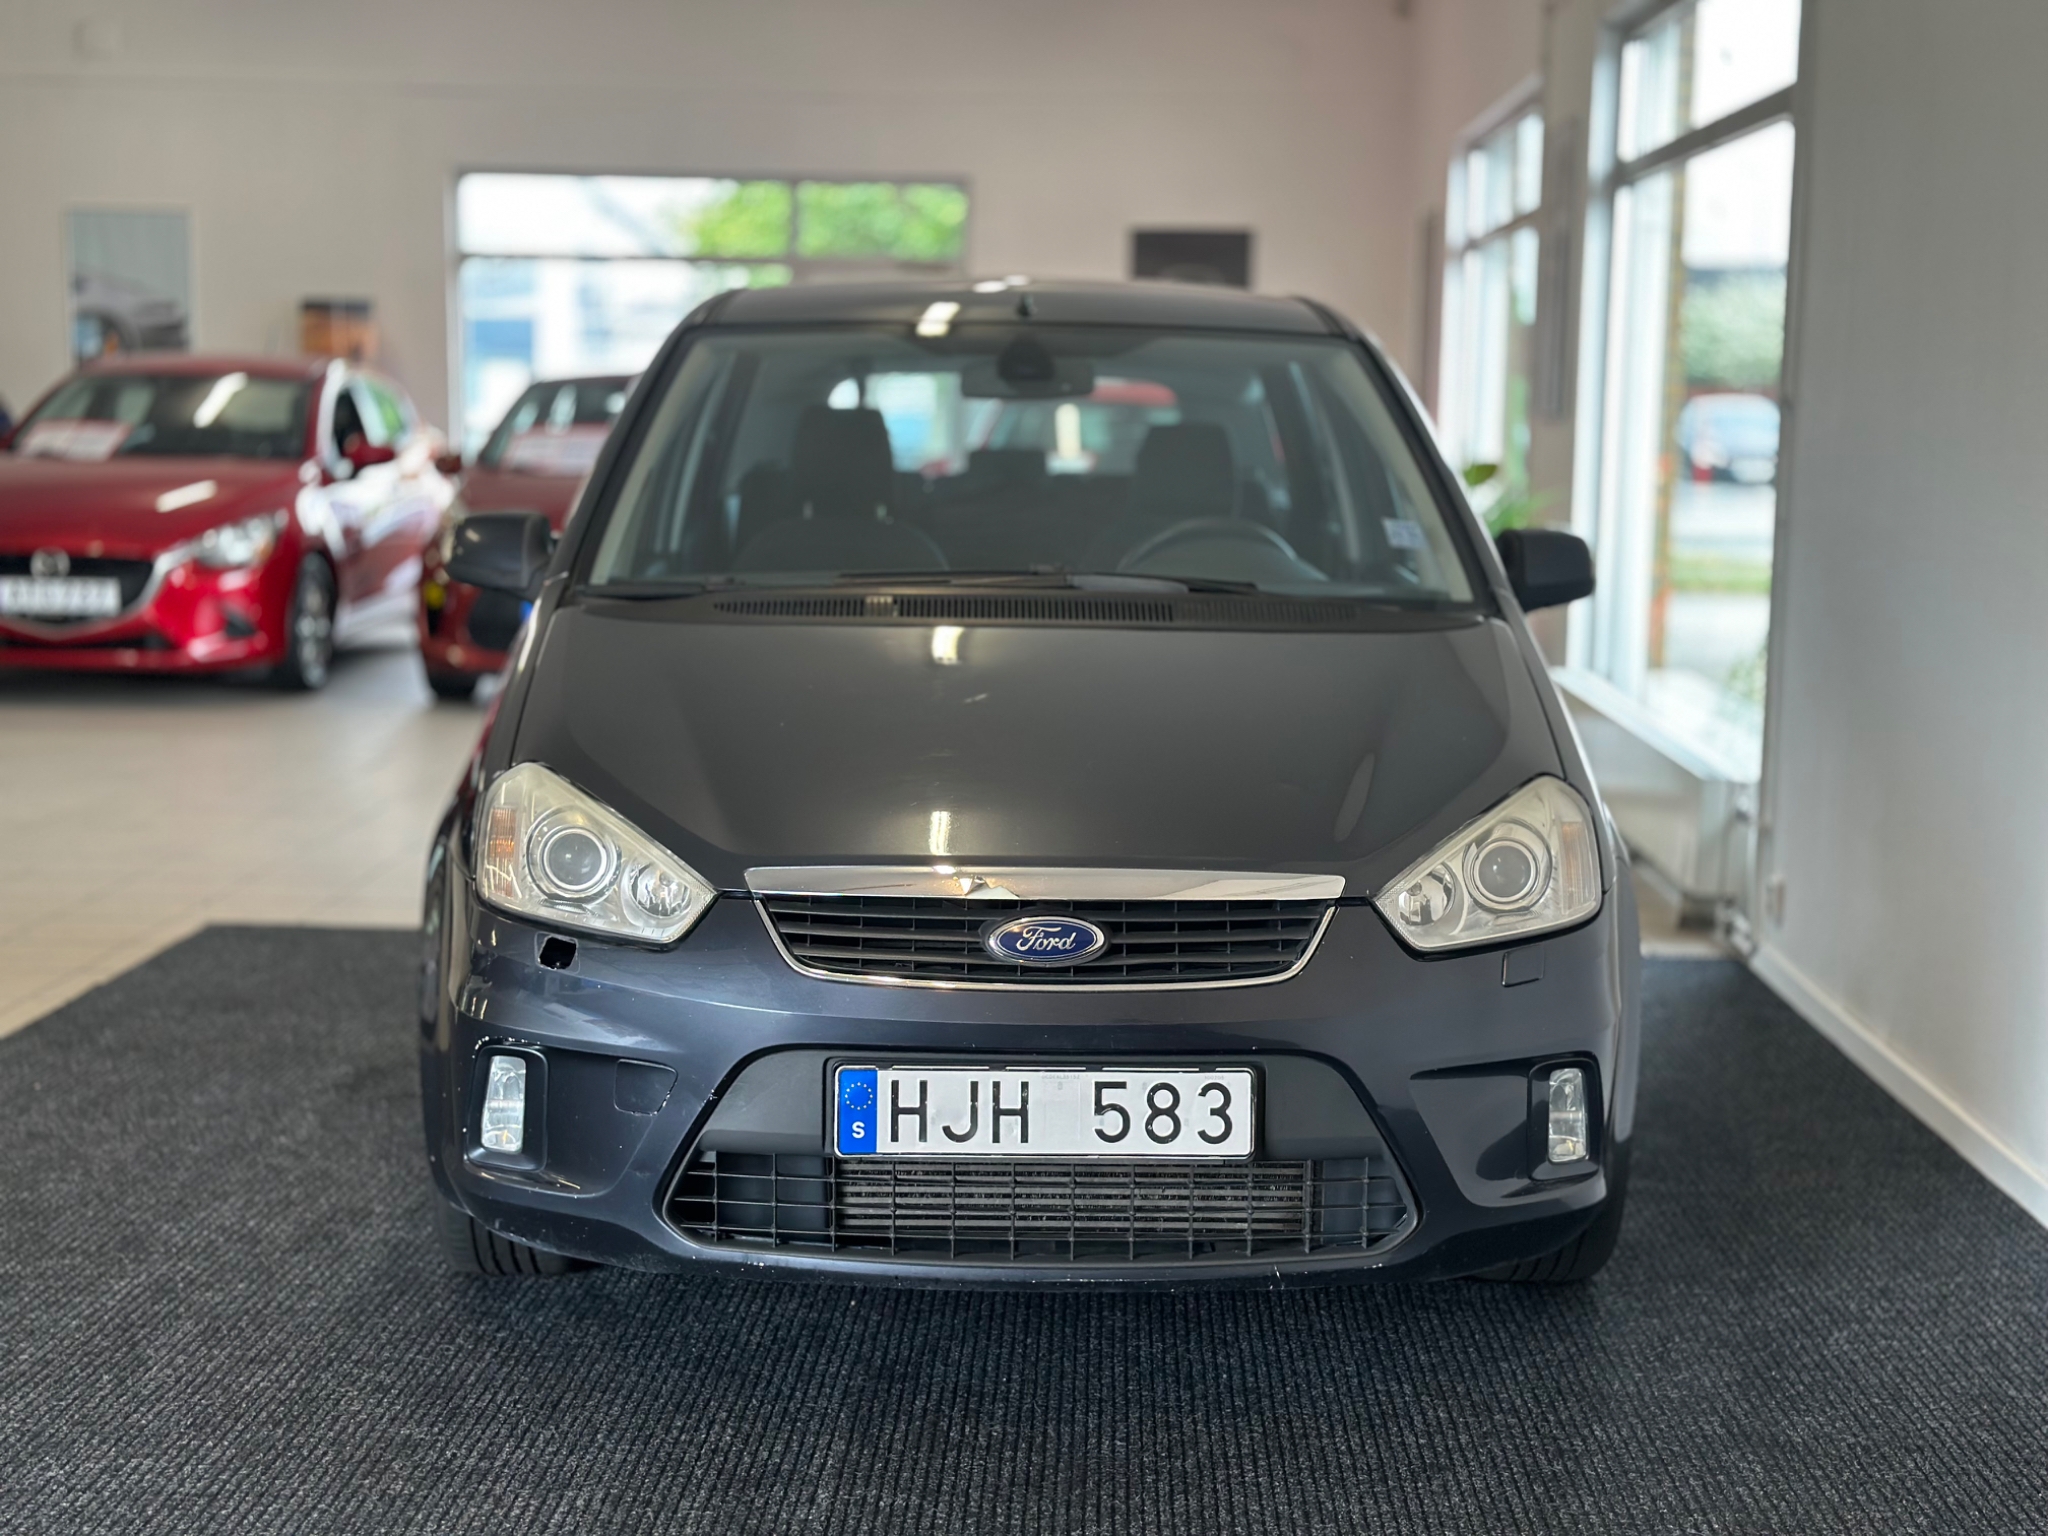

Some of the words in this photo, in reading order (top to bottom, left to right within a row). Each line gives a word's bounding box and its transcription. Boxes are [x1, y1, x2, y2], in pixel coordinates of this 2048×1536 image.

[1015, 926, 1077, 951] Ford
[890, 1079, 1029, 1143] HJH
[1094, 1080, 1233, 1145] 583
[851, 1121, 866, 1139] S
